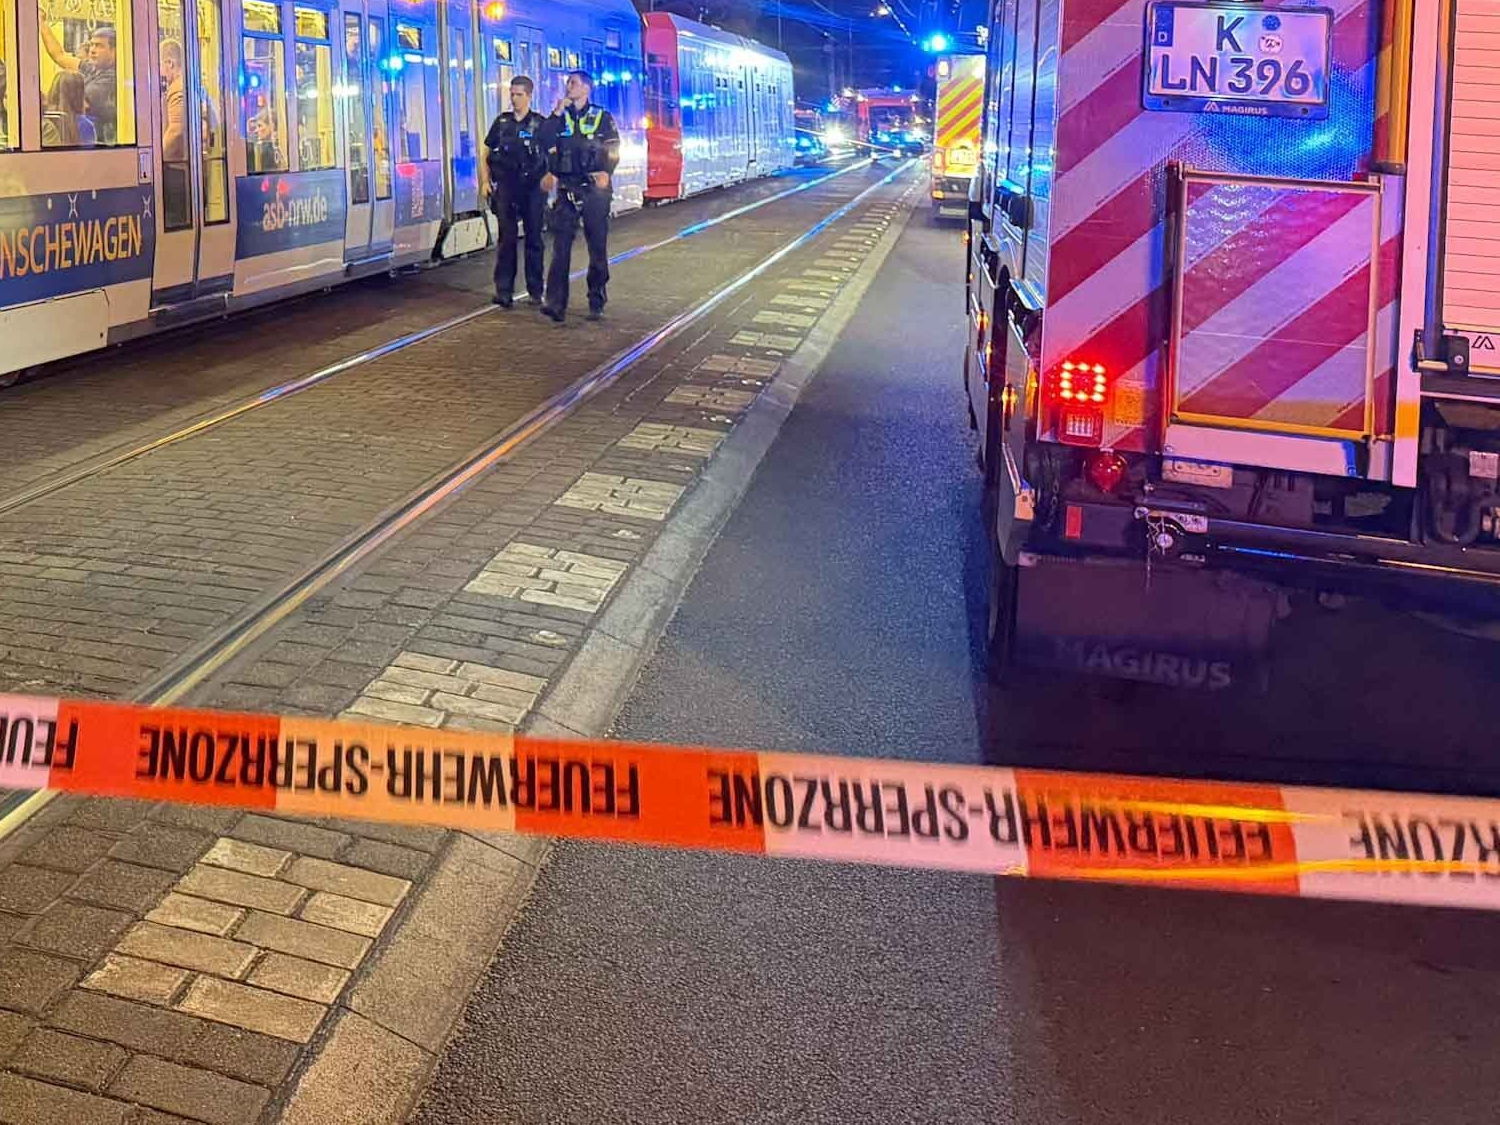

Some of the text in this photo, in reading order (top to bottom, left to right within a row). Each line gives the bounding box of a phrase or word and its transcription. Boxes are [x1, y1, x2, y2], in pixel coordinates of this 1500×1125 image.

[1157, 31, 1168, 43] D
[1216, 15, 1245, 53] K
[1161, 54, 1311, 97] LN 396
[1221, 105, 1269, 116] MAGIRUS
[262, 184, 328, 232] asb-nrw.de
[1055, 637, 1232, 690] MAGIRUS
[136, 723, 641, 819] FEUERWEHR-SPERRZONE
[707, 768, 1273, 863] FEUERWEHR-SPERRZONE
